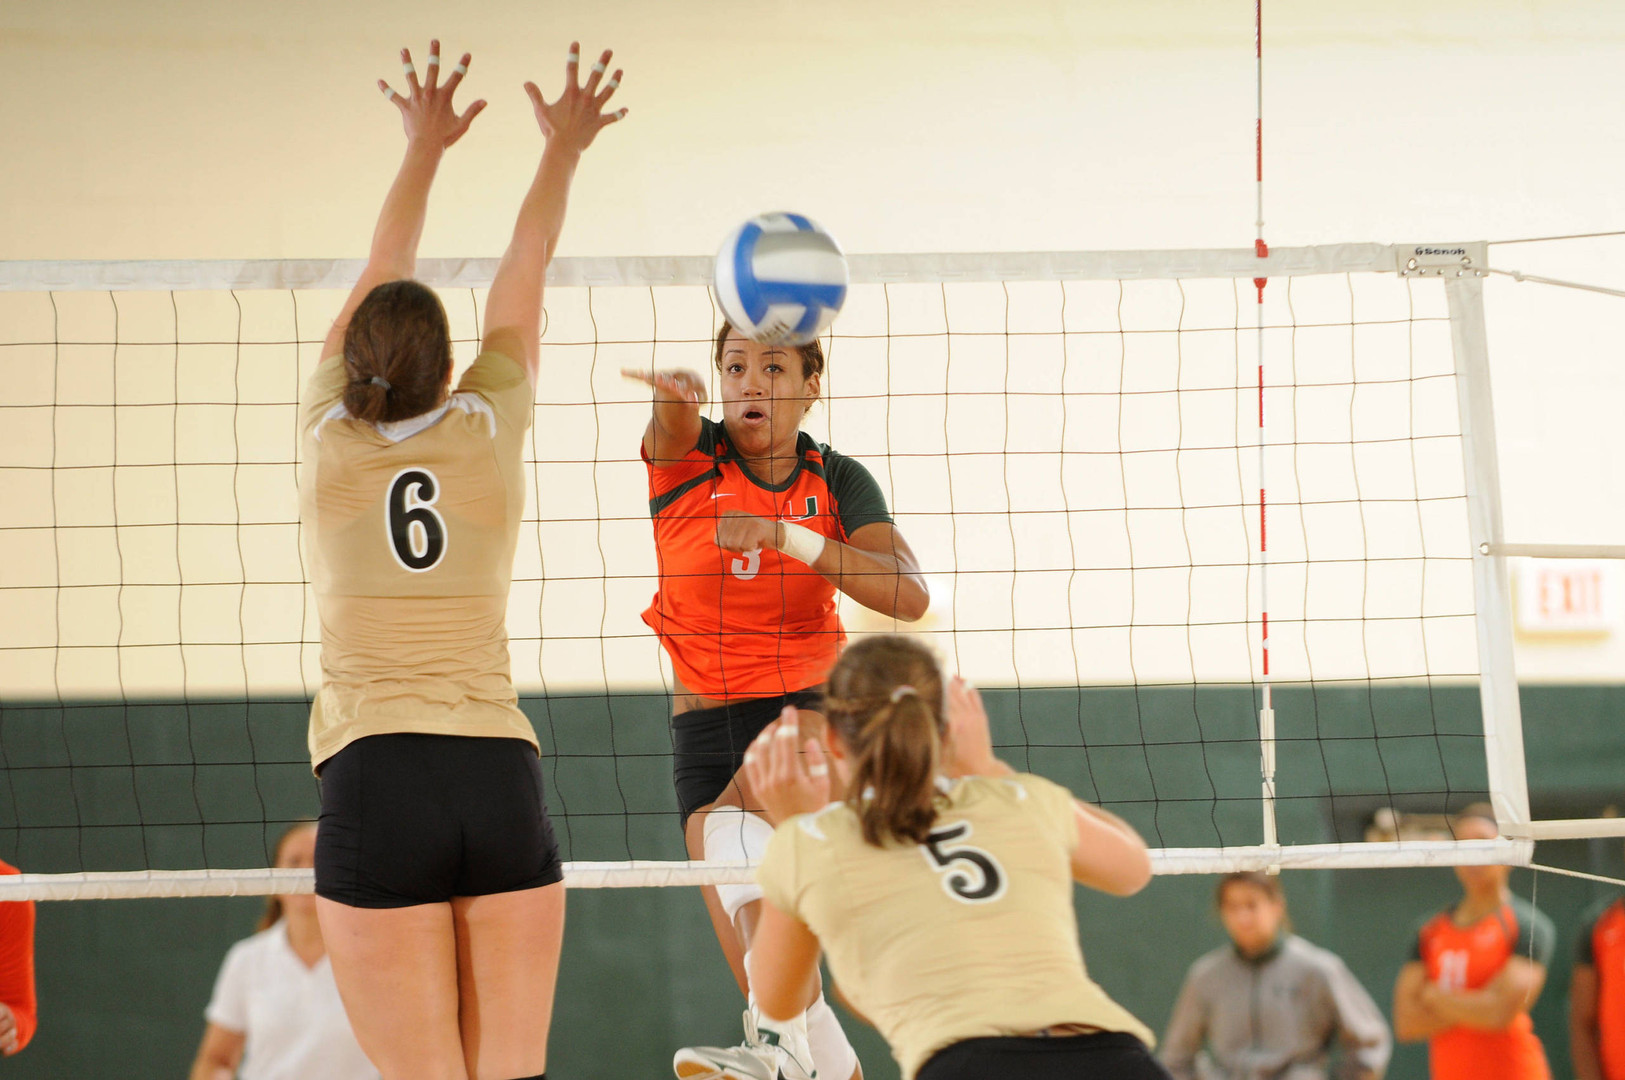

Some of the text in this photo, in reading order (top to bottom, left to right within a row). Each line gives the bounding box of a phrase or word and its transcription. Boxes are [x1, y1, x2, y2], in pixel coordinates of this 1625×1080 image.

[385, 466, 448, 573] 6
[1538, 569, 1603, 618] EXIT
[919, 820, 1008, 904] 5
